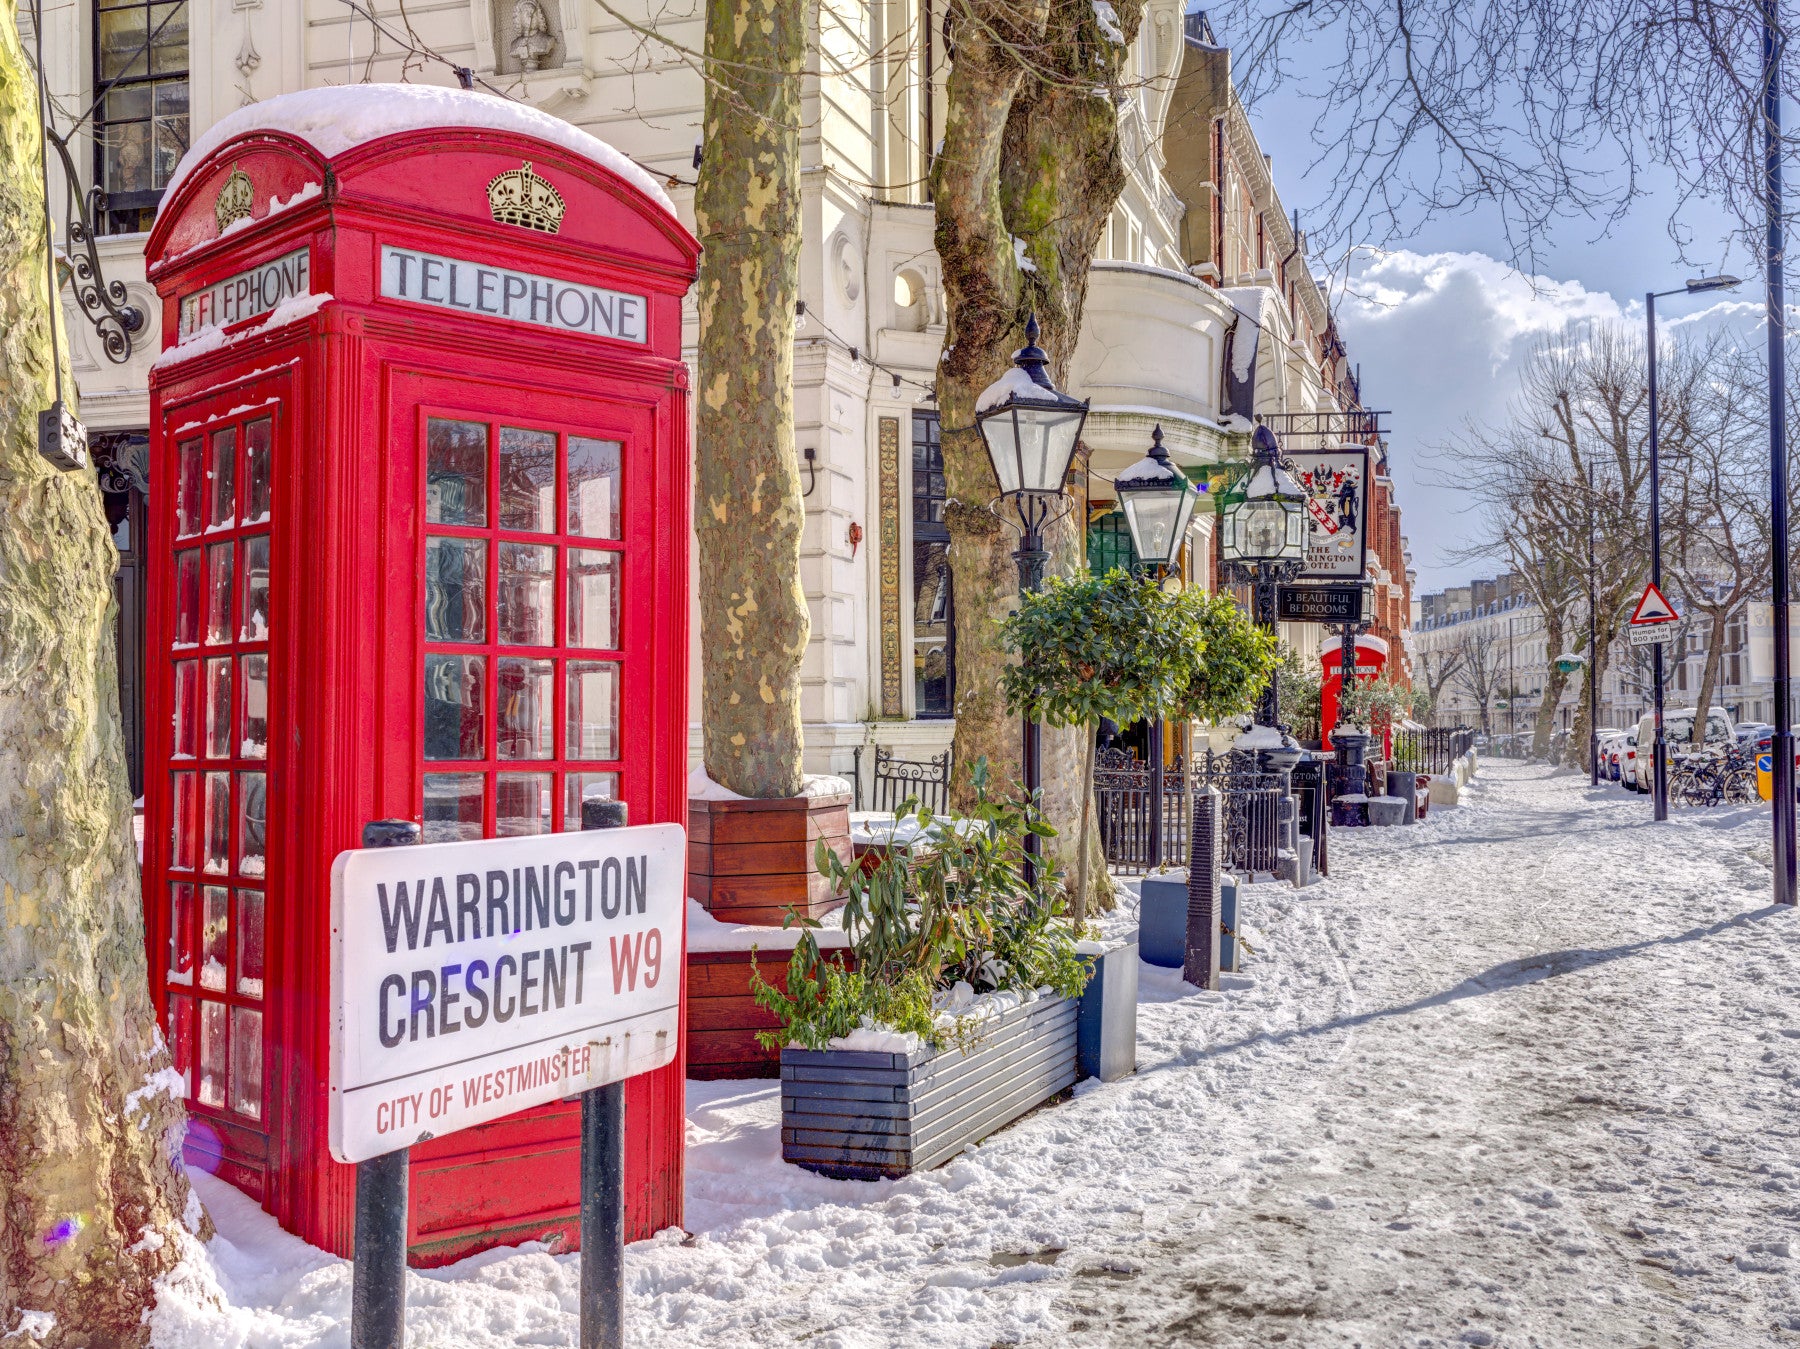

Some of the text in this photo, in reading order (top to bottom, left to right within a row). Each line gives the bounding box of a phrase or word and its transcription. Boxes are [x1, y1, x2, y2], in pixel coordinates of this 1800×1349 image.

[390, 252, 638, 340] TELEPHONE
[1310, 546, 1330, 554] THE
[1308, 554, 1355, 562] RINGTON
[1310, 562, 1337, 570] OTEL
[1286, 593, 1351, 604] 5 BEAUTIFUL
[1289, 603, 1348, 614] BEDROOMS
[376, 855, 648, 954] WARRINGTON
[378, 927, 662, 1049] CRESCENT W9
[376, 1046, 592, 1135] CITY OF WESTMINSTER
